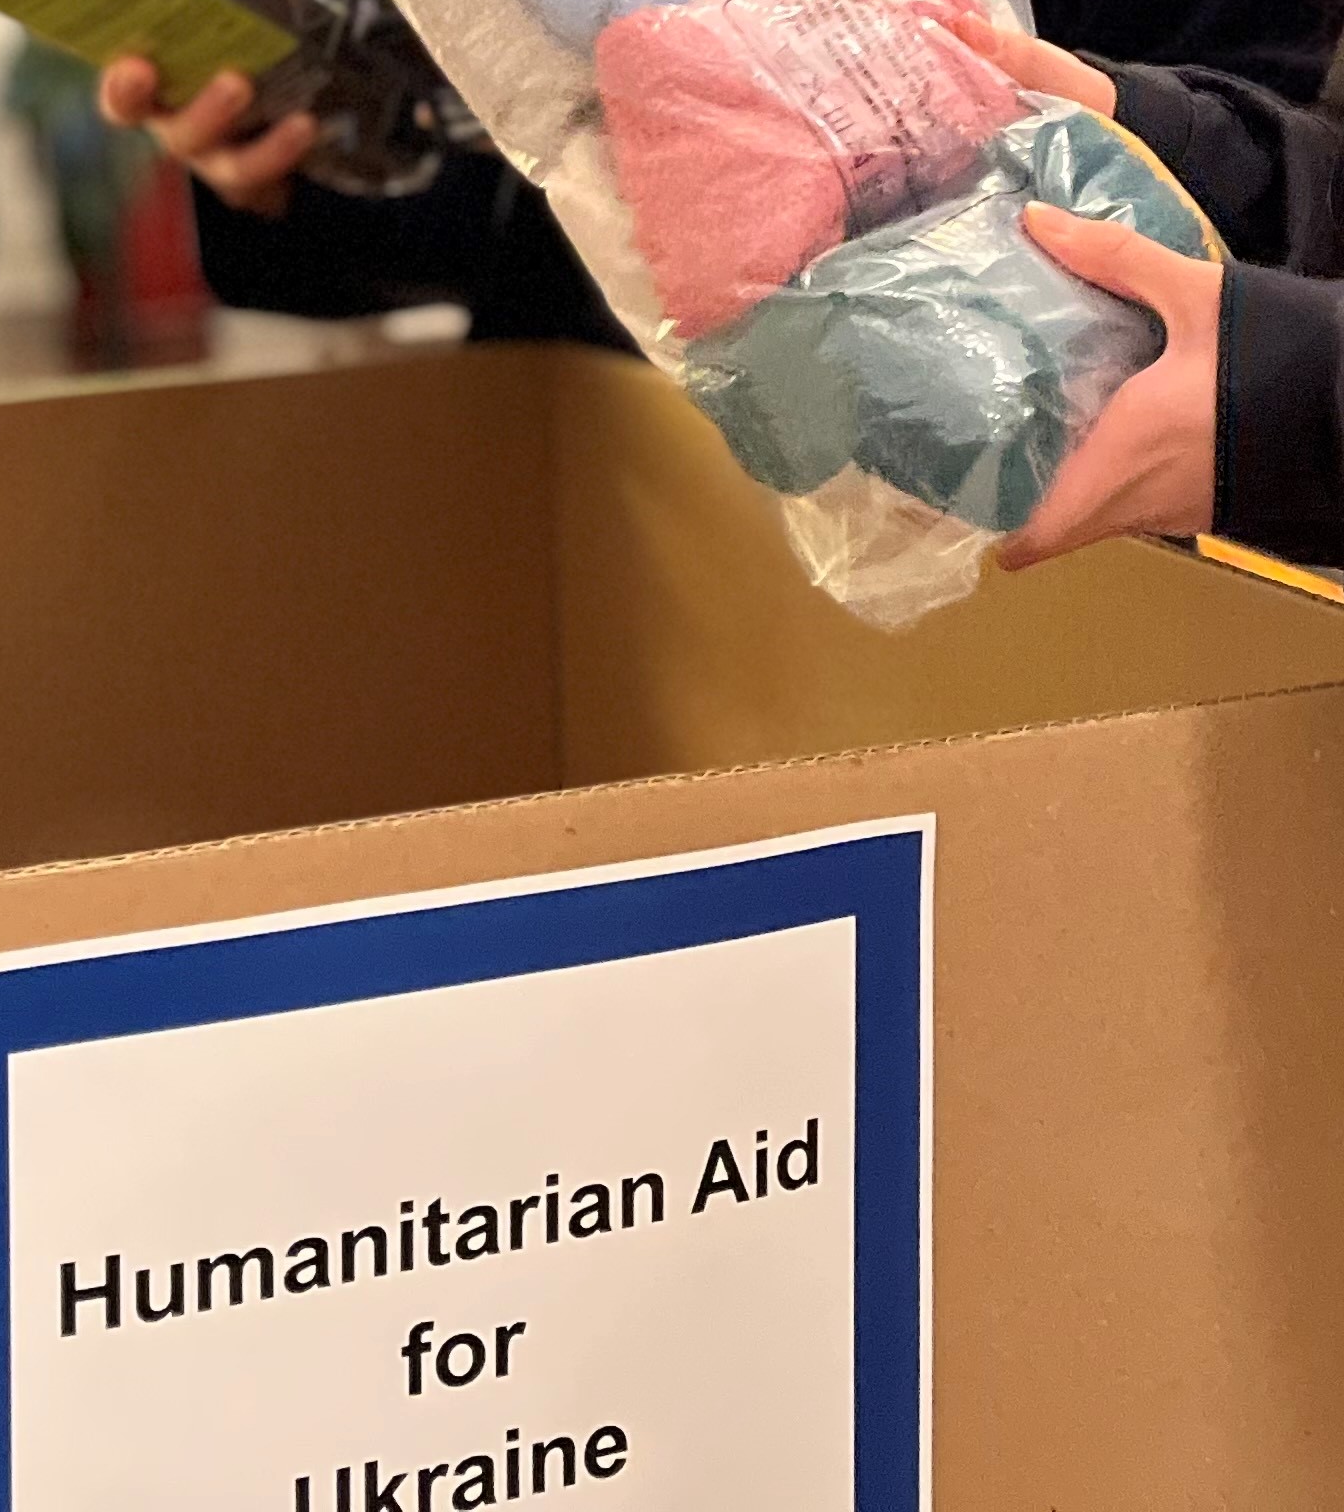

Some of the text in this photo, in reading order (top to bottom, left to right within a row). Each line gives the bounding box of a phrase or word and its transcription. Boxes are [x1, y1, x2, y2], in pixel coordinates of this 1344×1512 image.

[60, 1117, 820, 1337] Humanitarian Aid
[400, 1321, 527, 1396] for
